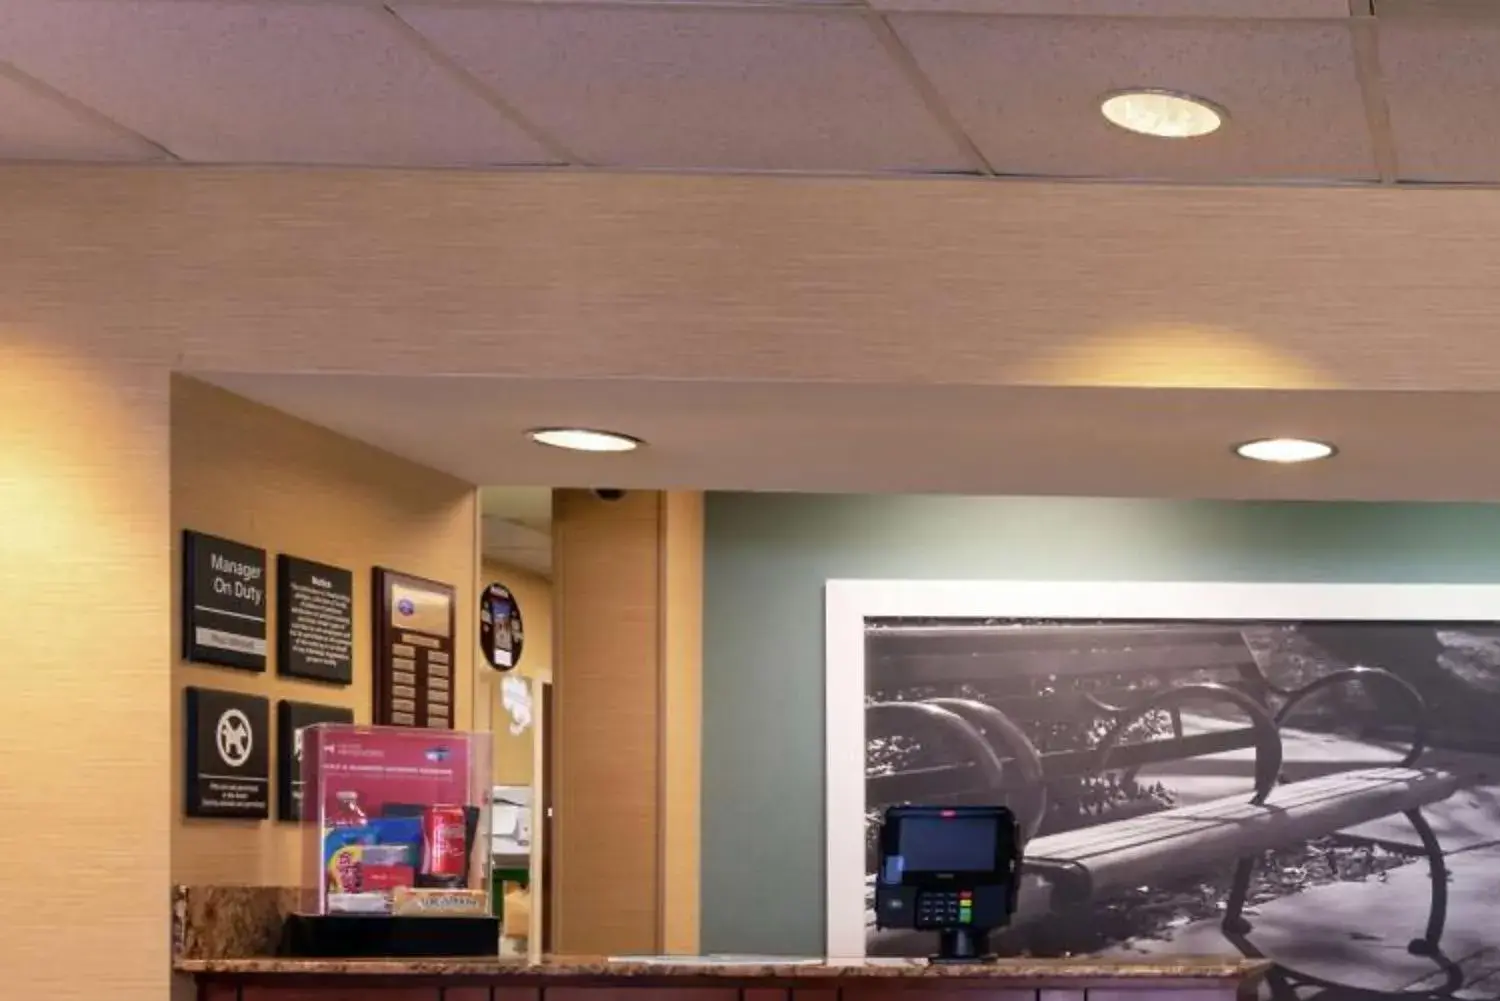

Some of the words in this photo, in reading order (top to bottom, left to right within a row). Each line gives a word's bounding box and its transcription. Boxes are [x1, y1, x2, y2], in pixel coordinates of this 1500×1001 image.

[210, 552, 262, 581] Manager
[213, 577, 232, 597] On
[234, 580, 262, 606] Duty
